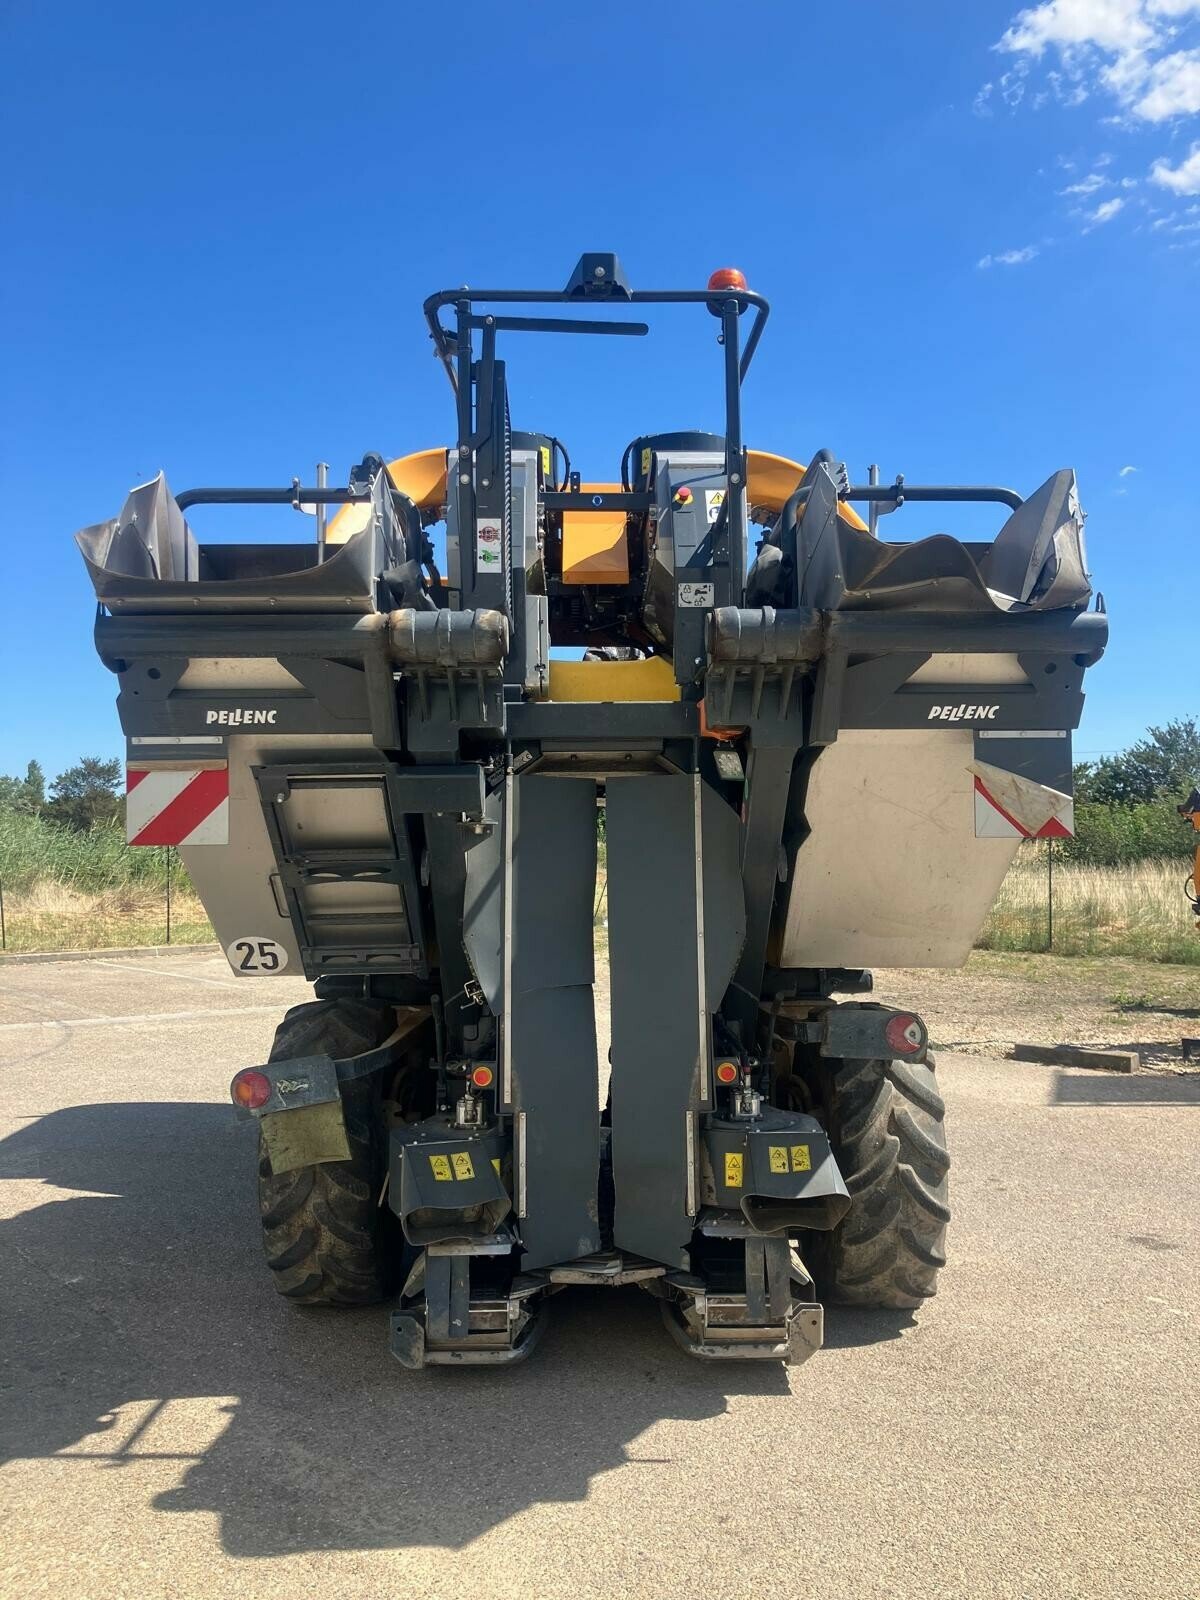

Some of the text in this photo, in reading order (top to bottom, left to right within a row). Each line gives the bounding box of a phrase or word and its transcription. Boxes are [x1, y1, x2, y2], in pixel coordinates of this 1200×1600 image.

[206, 708, 277, 726] PELLENC
[927, 704, 1000, 721] PELLENC
[235, 942, 279, 970] 25
